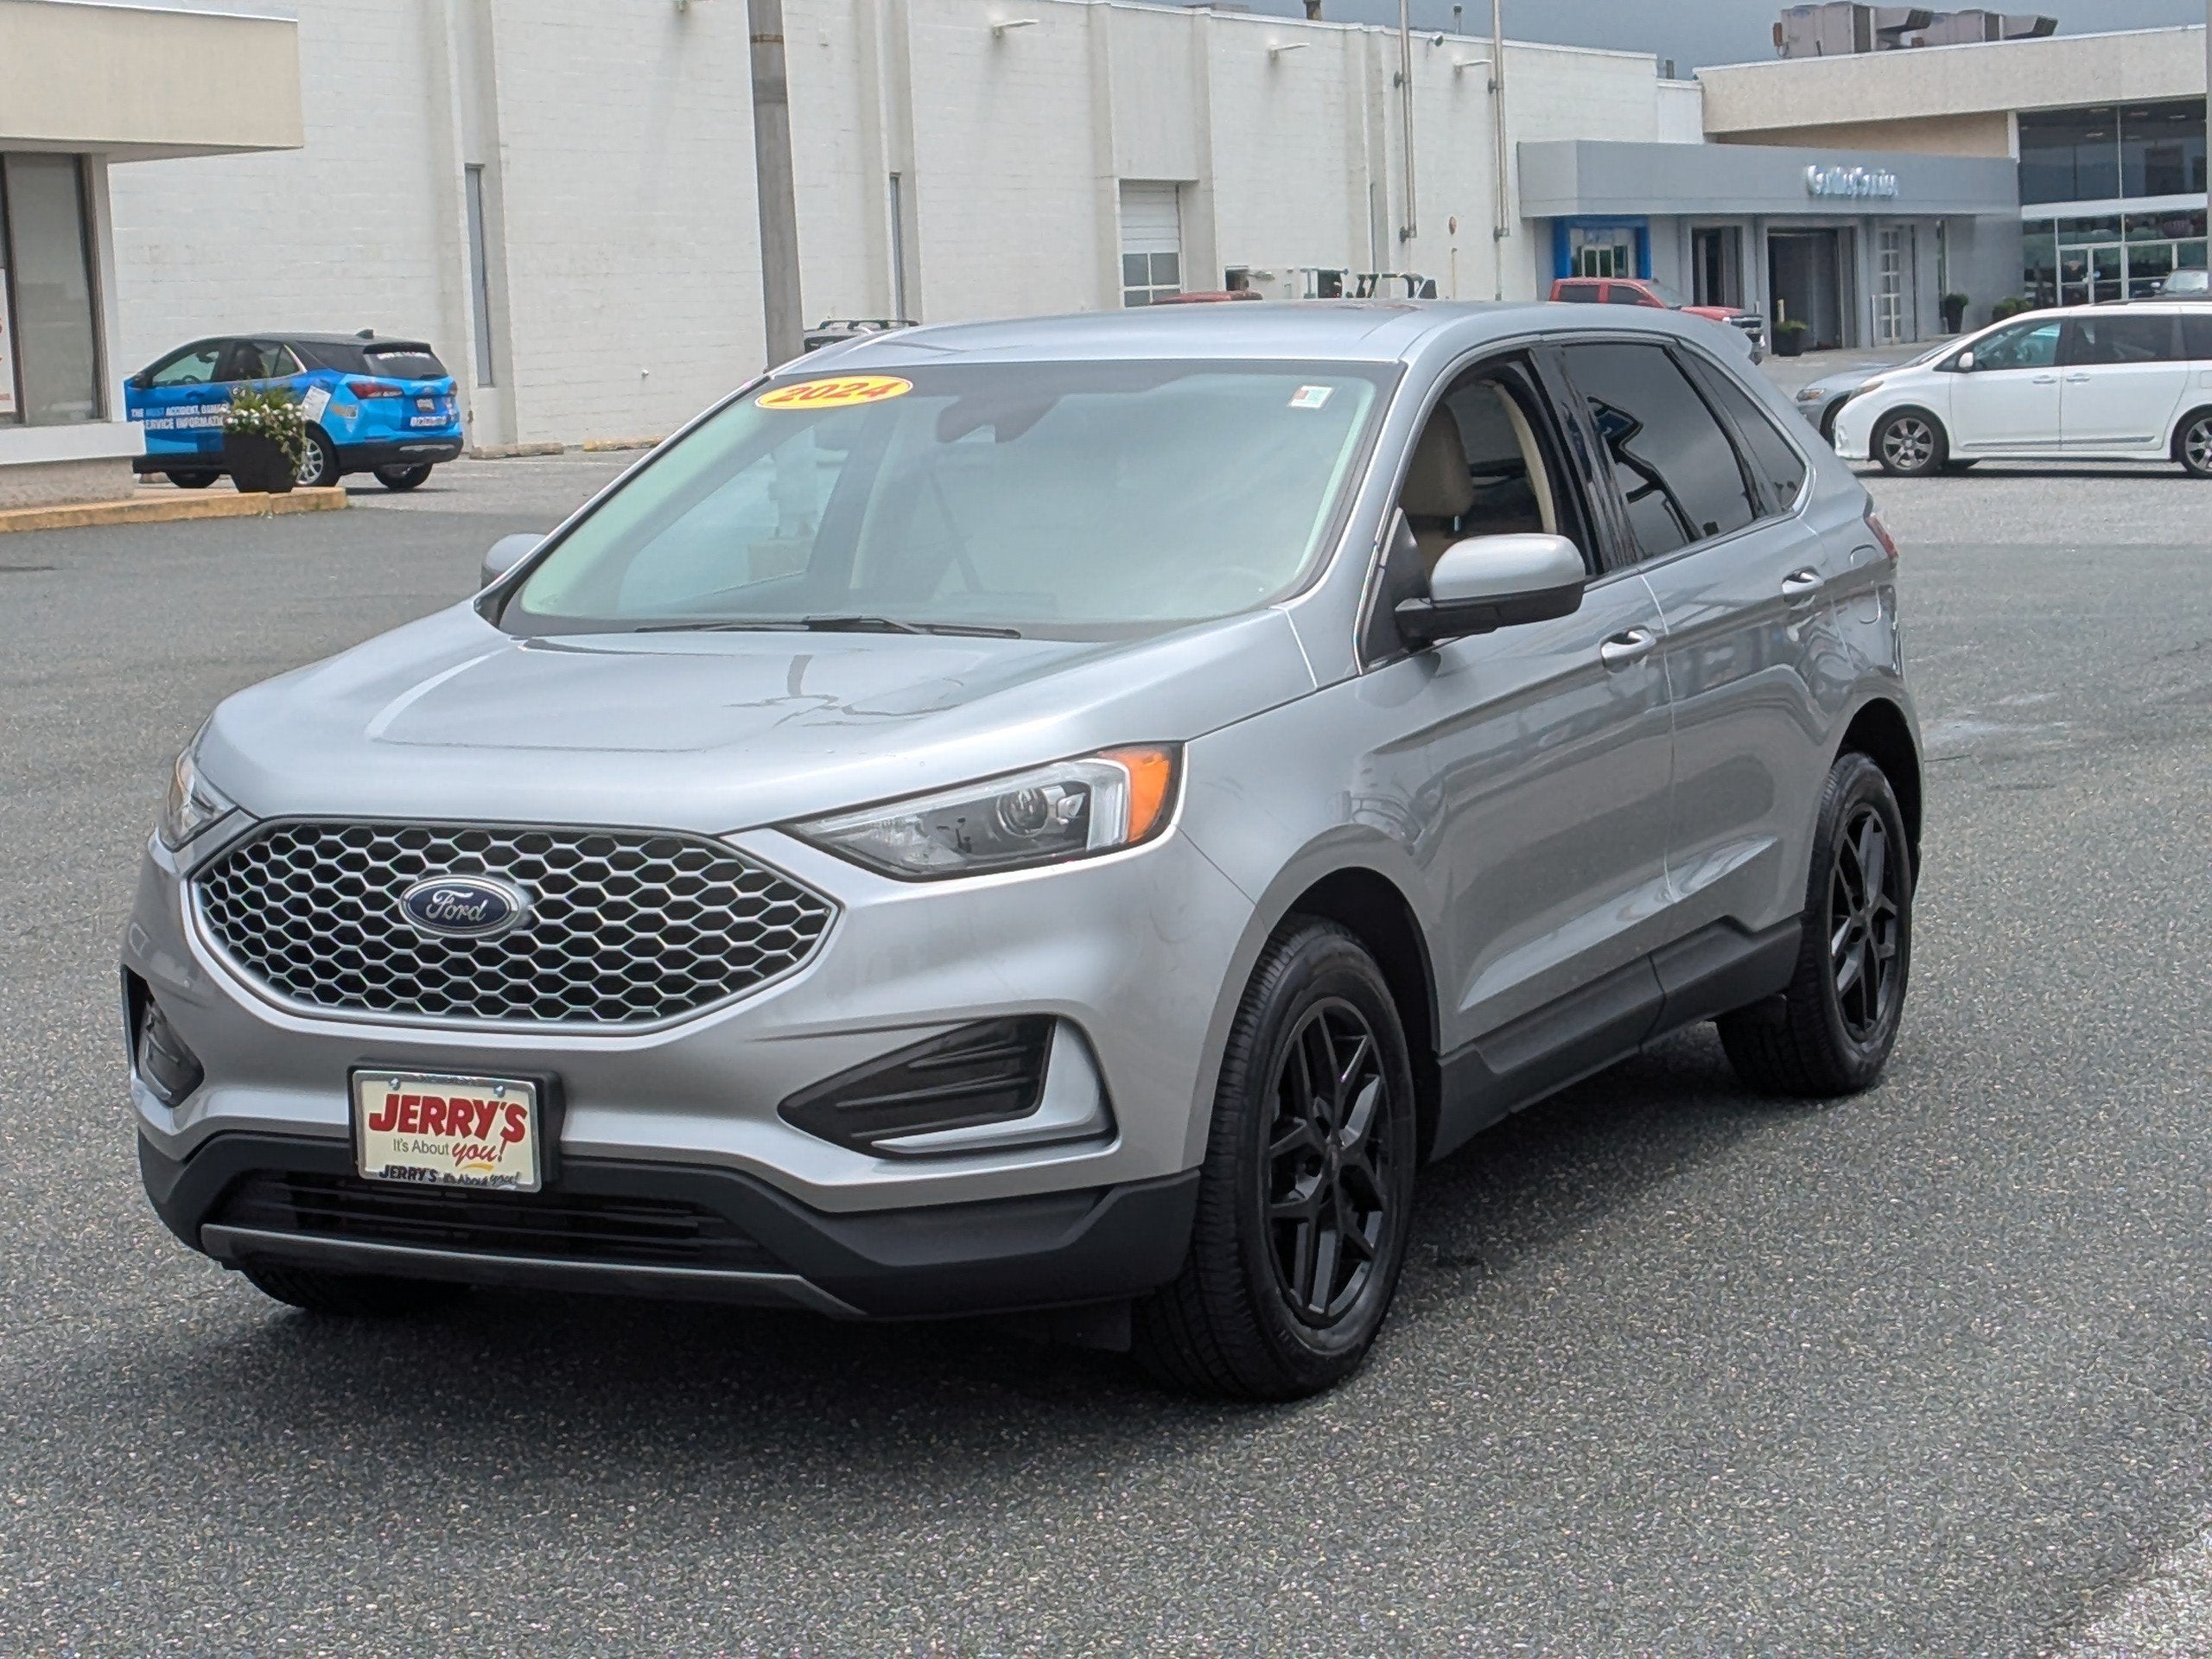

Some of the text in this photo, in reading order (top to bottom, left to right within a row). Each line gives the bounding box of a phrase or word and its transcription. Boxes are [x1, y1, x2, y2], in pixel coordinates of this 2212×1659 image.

[766, 382, 902, 404] 2024
[425, 889, 489, 922] Ford
[369, 1093, 528, 1143] JERRY'S
[393, 1138, 507, 1166] It's About you!
[378, 1164, 439, 1184] JERRY'S
